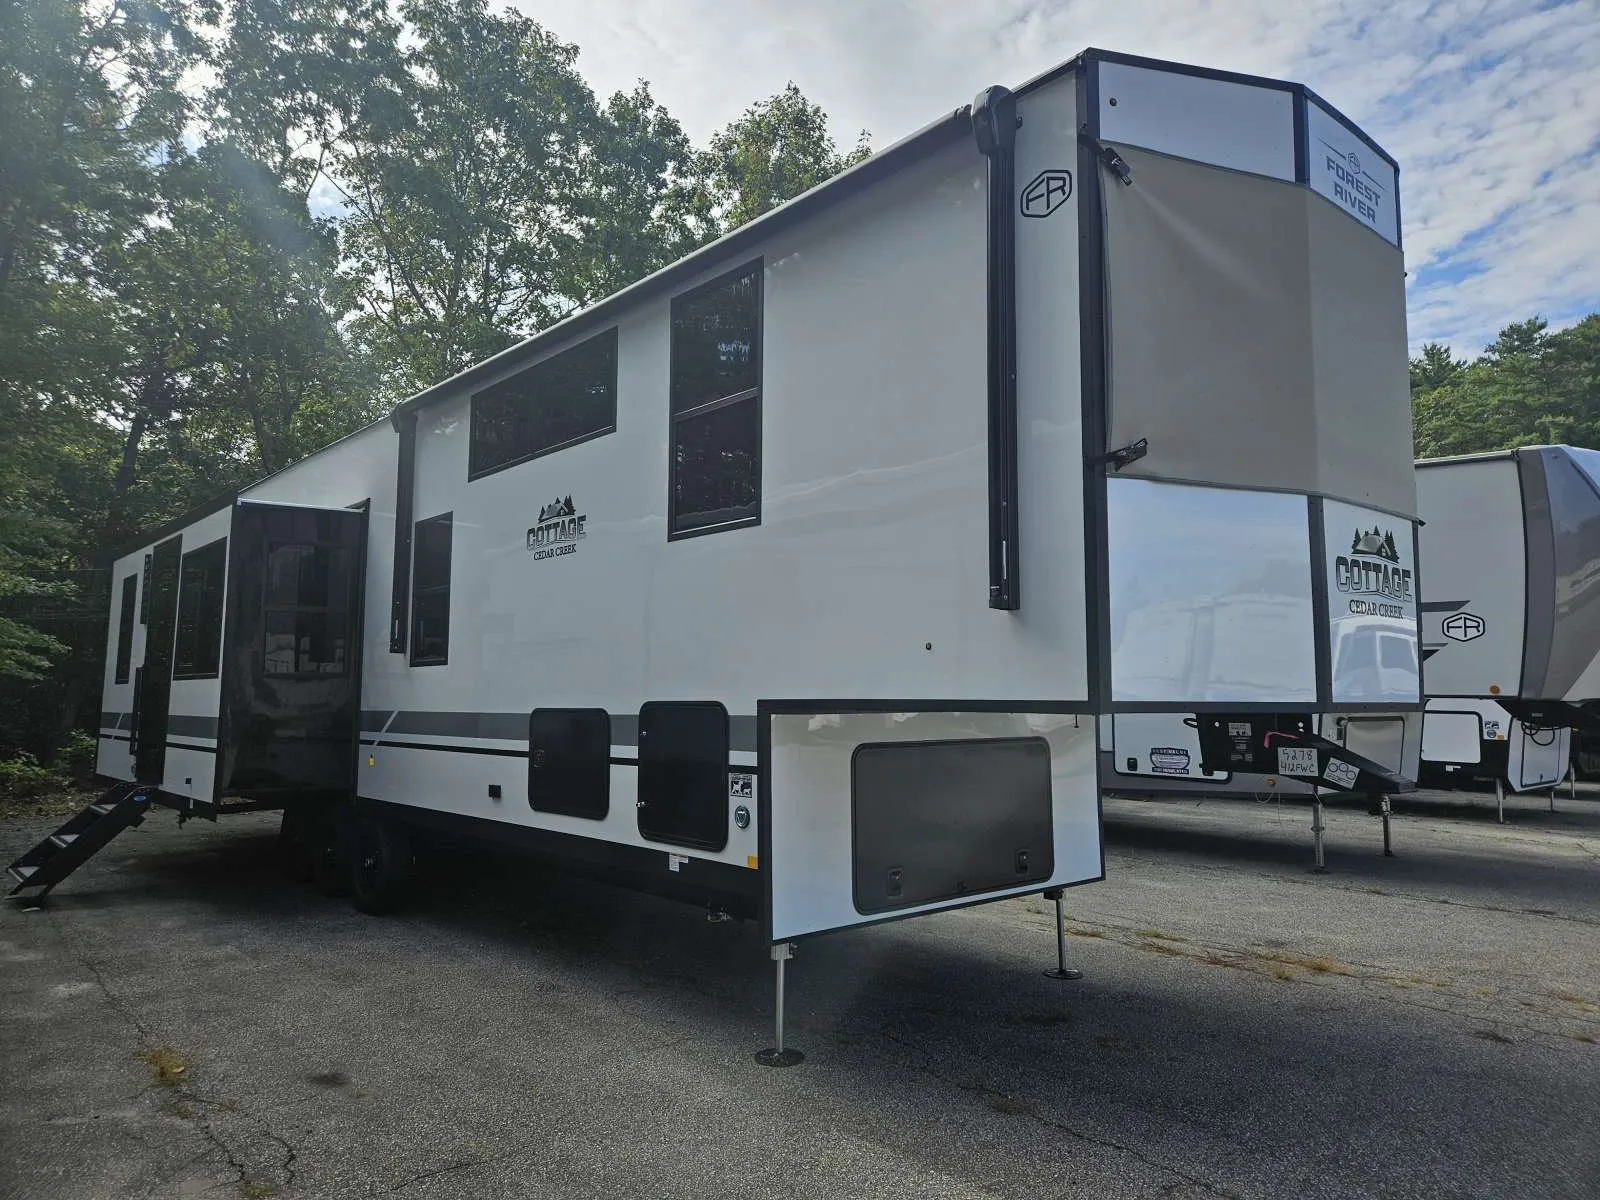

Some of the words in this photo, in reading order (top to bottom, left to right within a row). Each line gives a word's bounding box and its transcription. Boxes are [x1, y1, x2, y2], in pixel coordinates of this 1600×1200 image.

[1025, 175, 1067, 211] FR
[1326, 155, 1381, 207] FOREST
[1334, 180, 1376, 224] RIVER
[526, 514, 587, 551] COTTAGE
[534, 549, 555, 561] CEDAR
[555, 543, 577, 557] CREEK
[1335, 555, 1413, 602] COTTAGE
[1349, 599, 1378, 616] CEDAR
[1378, 603, 1404, 619] CREEK
[1446, 615, 1481, 639] FR
